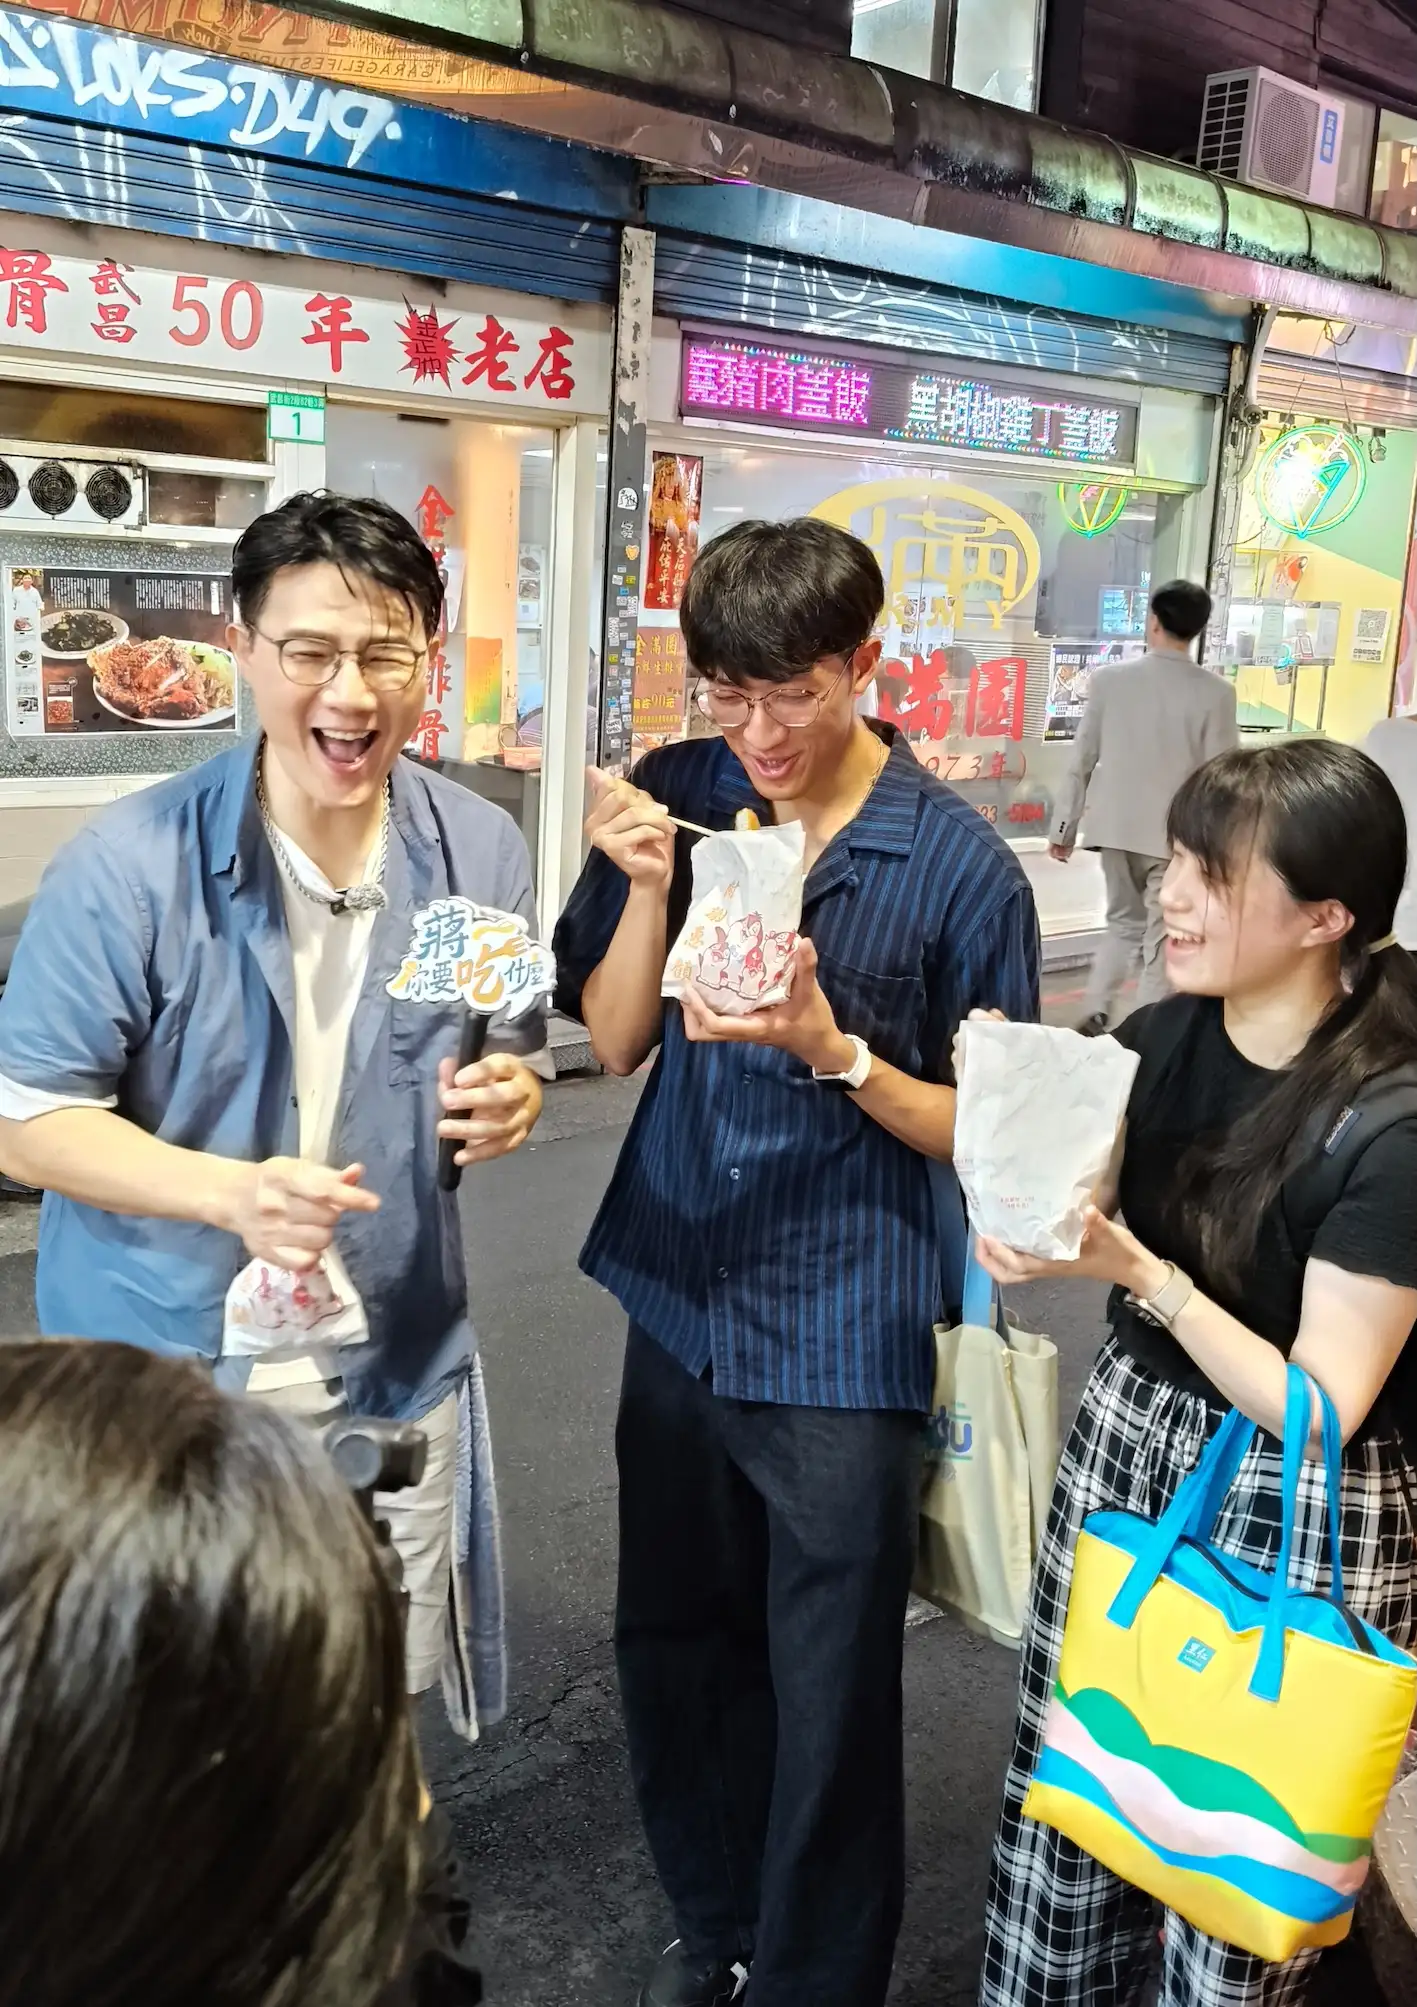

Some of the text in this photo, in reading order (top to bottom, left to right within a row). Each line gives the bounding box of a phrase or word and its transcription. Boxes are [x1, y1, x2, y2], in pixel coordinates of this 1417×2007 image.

[89, 257, 142, 343] 武昌
[169, 275, 264, 350] 50
[301, 292, 370, 373] 年
[462, 314, 575, 399] 老店
[292, 412, 300, 436] 1
[411, 484, 455, 762] 金排骨
[415, 907, 469, 960] 蔣
